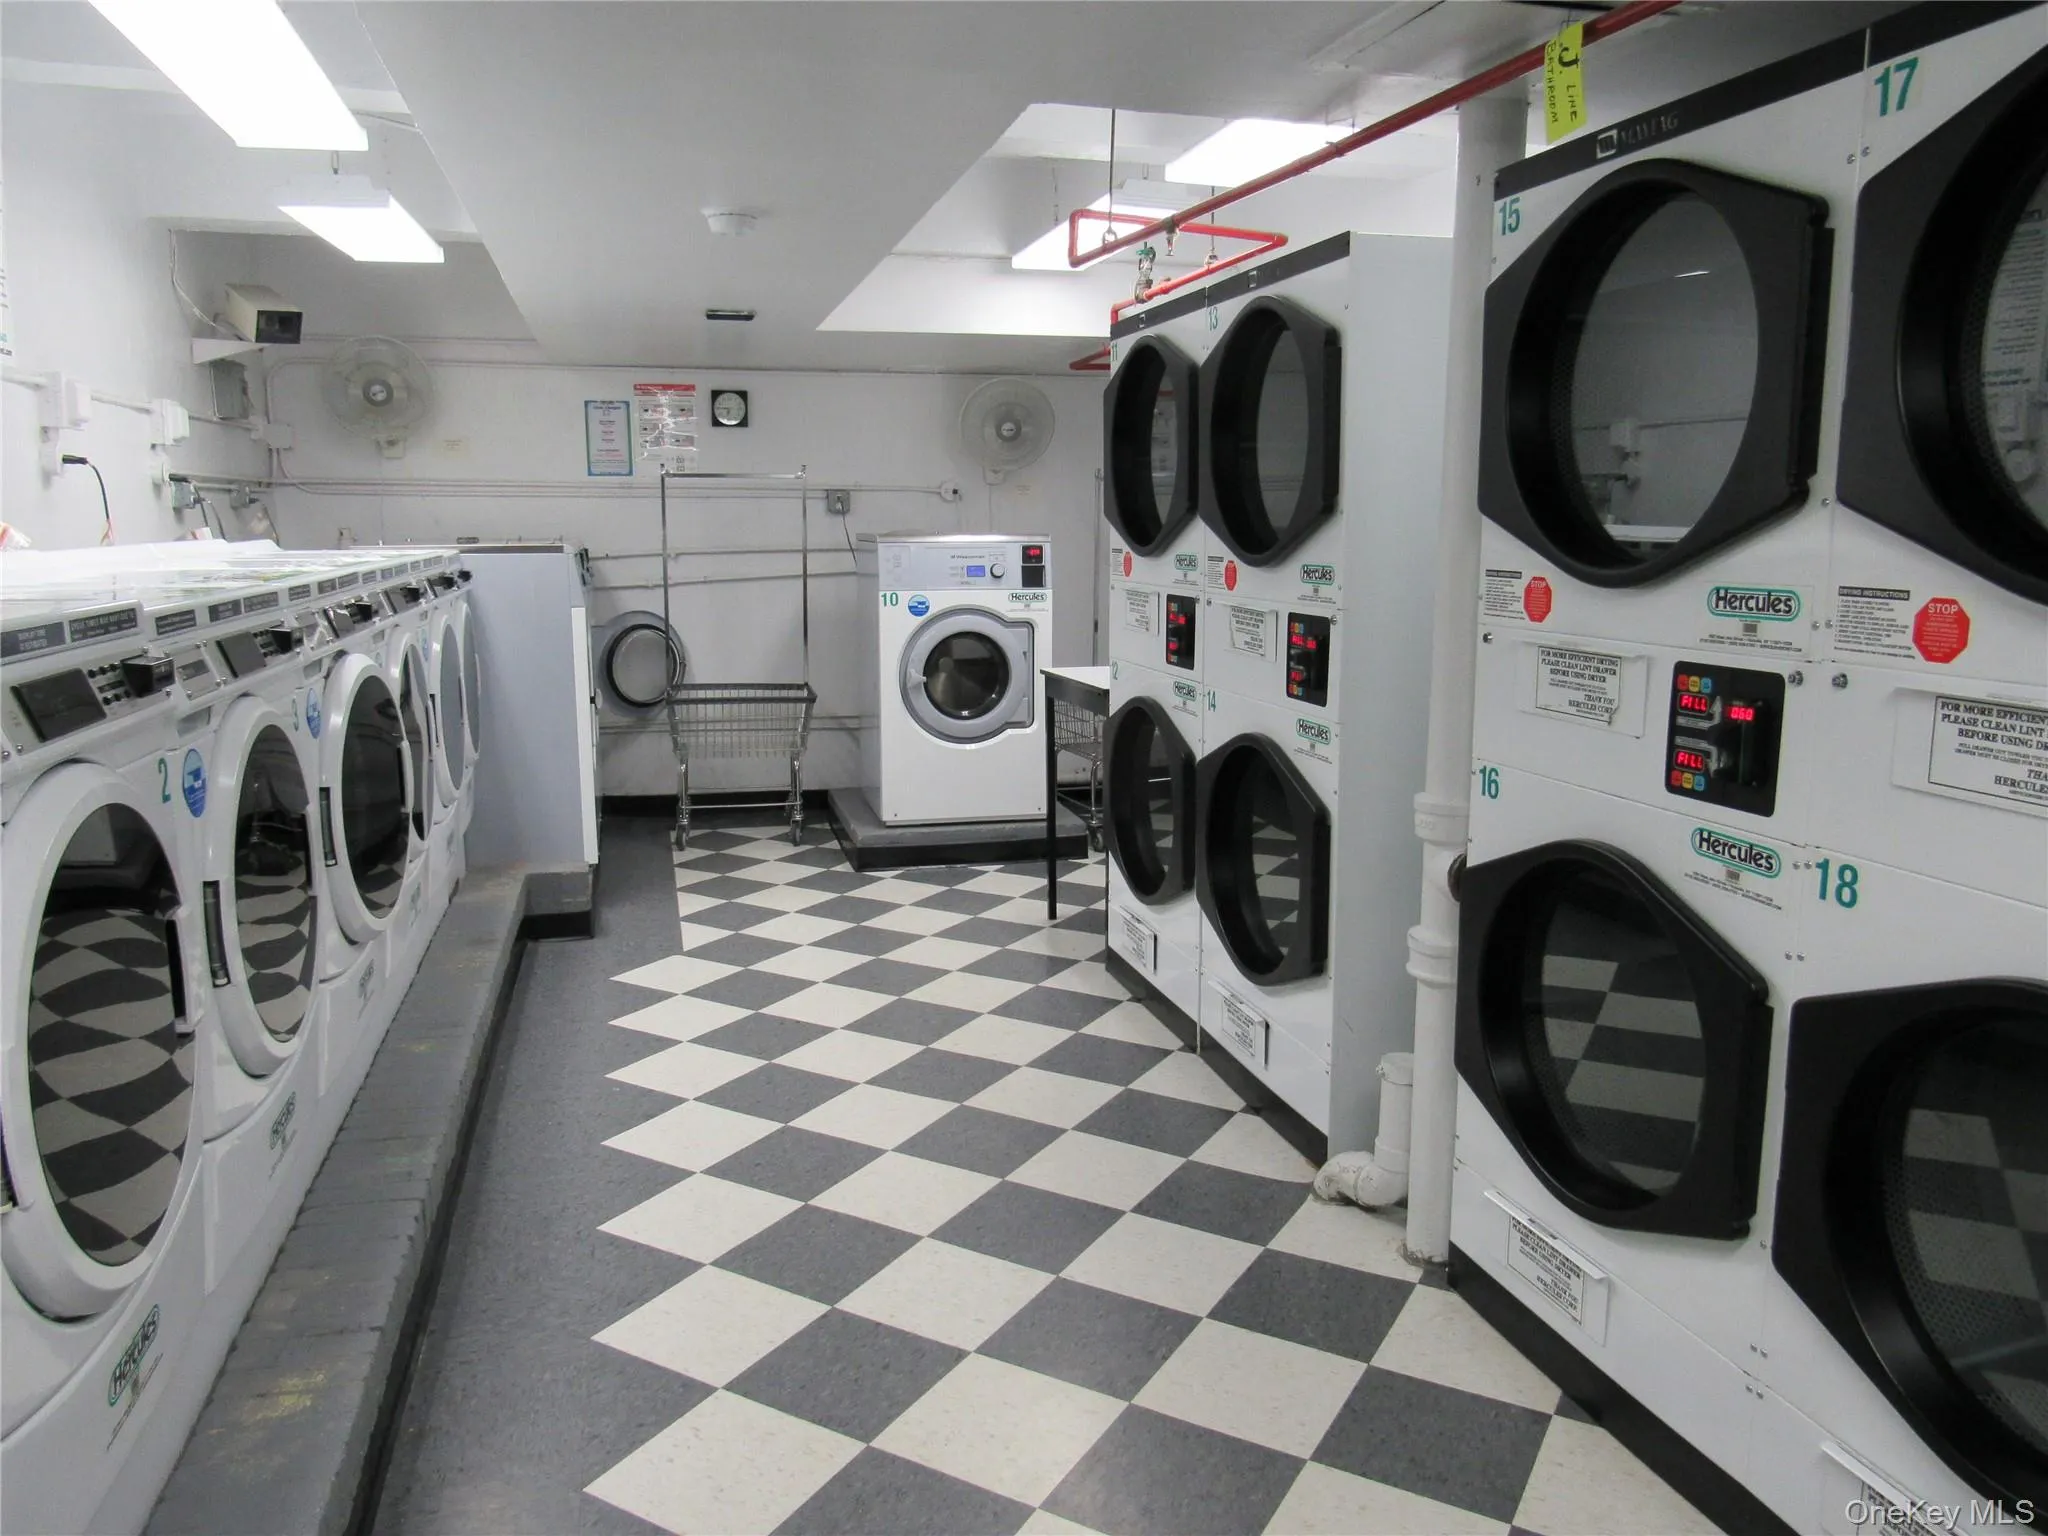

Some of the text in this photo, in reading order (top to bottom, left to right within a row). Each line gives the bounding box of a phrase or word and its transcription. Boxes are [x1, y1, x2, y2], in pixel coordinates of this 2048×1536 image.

[1546, 41, 1559, 123] BATHROOM
[1874, 56, 1919, 117] 17
[1499, 197, 1520, 236] 15
[1209, 306, 1218, 331] 13
[1302, 565, 1333, 582] Hercules
[881, 592, 899, 606] 10
[1011, 592, 1045, 602] Hercules
[1715, 588, 1793, 614] Hercules
[1927, 603, 1958, 615] STOP
[1207, 689, 1216, 712] 14
[1940, 701, 1961, 713] FOR
[1962, 704, 1995, 717] MORE
[1298, 718, 1329, 742] Hercules
[1941, 713, 2045, 738] PLEASE CLEAN LINT
[1957, 728, 1999, 743] BEFORE
[2000, 734, 2033, 749] USING
[158, 757, 171, 804] 2
[1479, 765, 1499, 800] 16
[1699, 830, 1774, 872] Hercules
[1815, 858, 1859, 909] 18
[113, 1310, 159, 1396] Hercules
